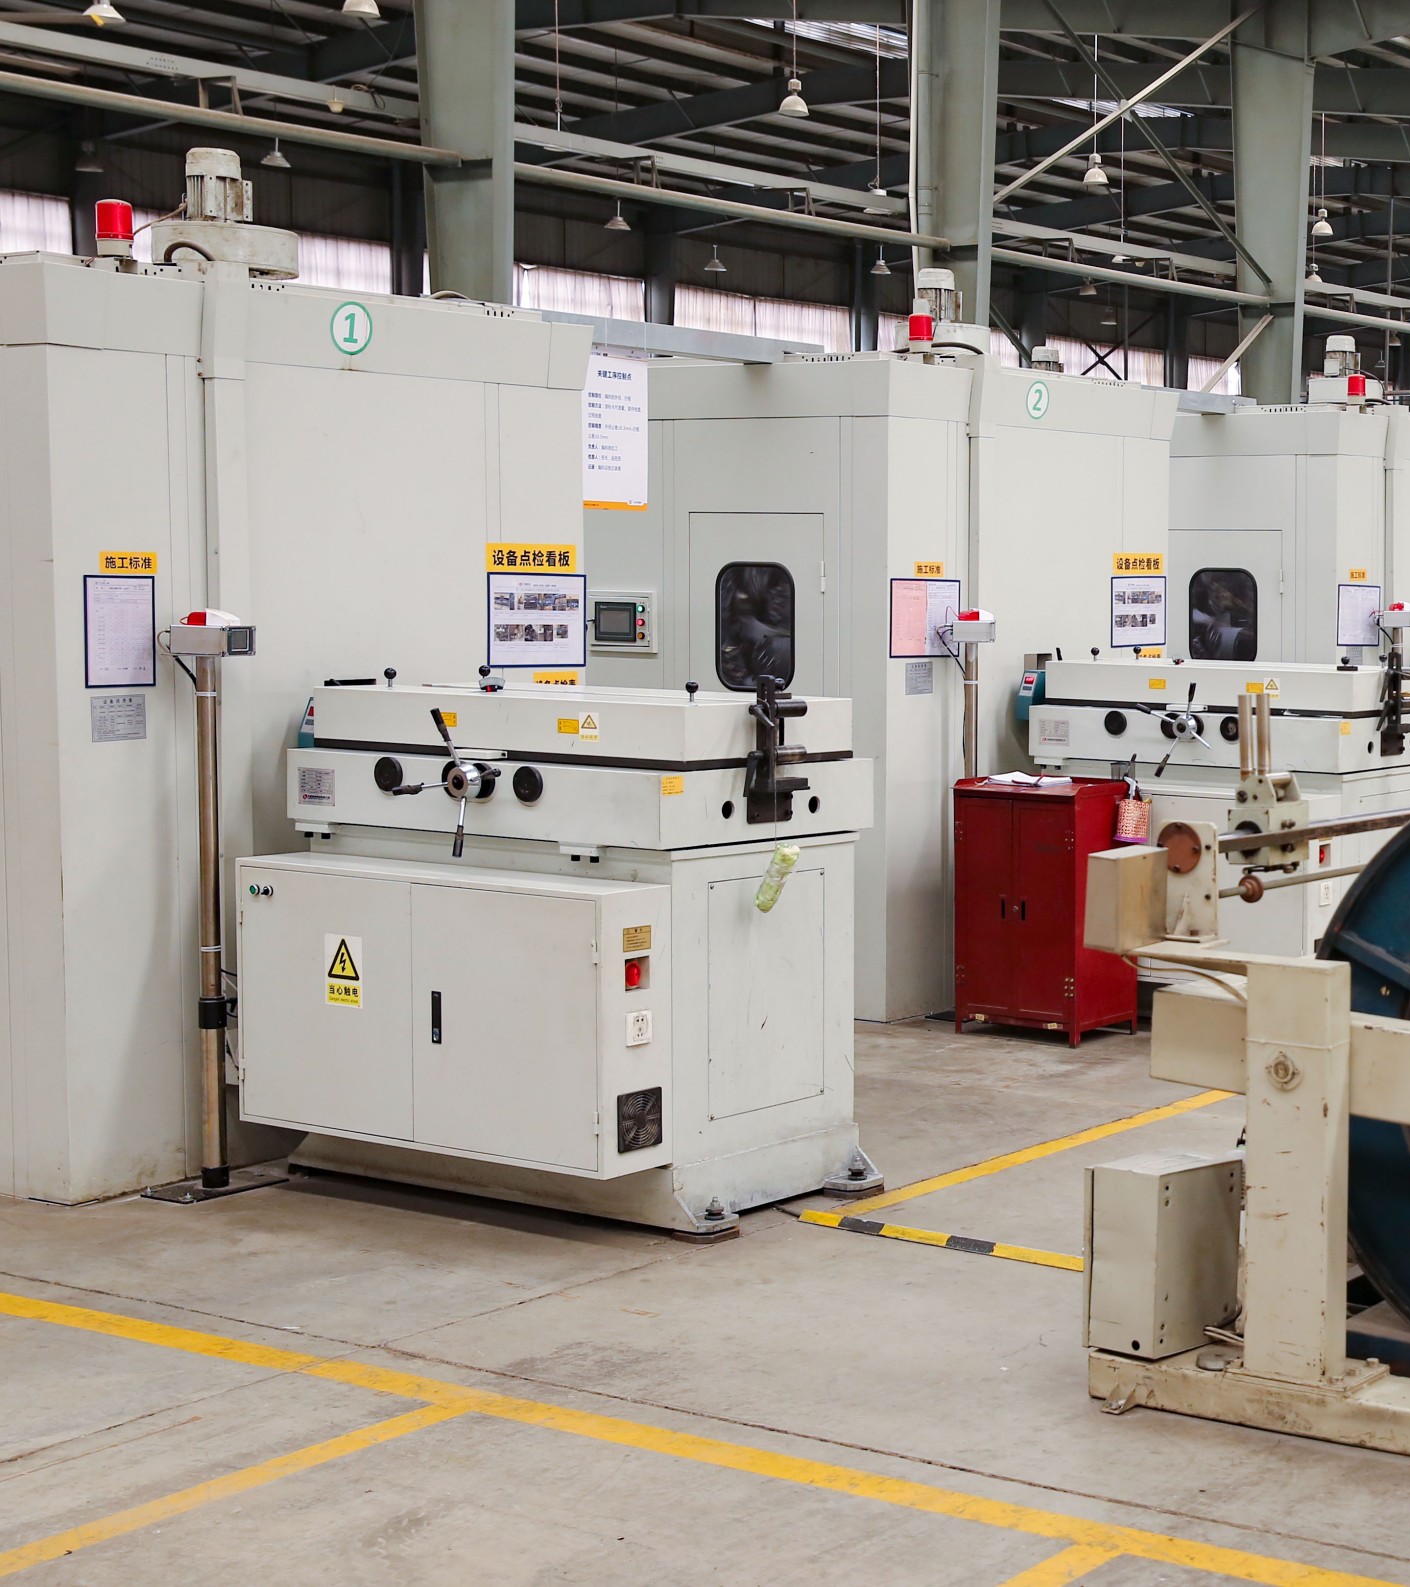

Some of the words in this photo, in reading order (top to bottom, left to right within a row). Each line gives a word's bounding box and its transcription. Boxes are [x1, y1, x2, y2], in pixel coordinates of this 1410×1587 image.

[104, 556, 153, 570] 施工标准
[492, 549, 571, 568] 设备点检看板
[1116, 557, 1160, 571] 设备点检看板
[916, 564, 941, 575] 施工标准
[328, 984, 359, 998] 当心触电
